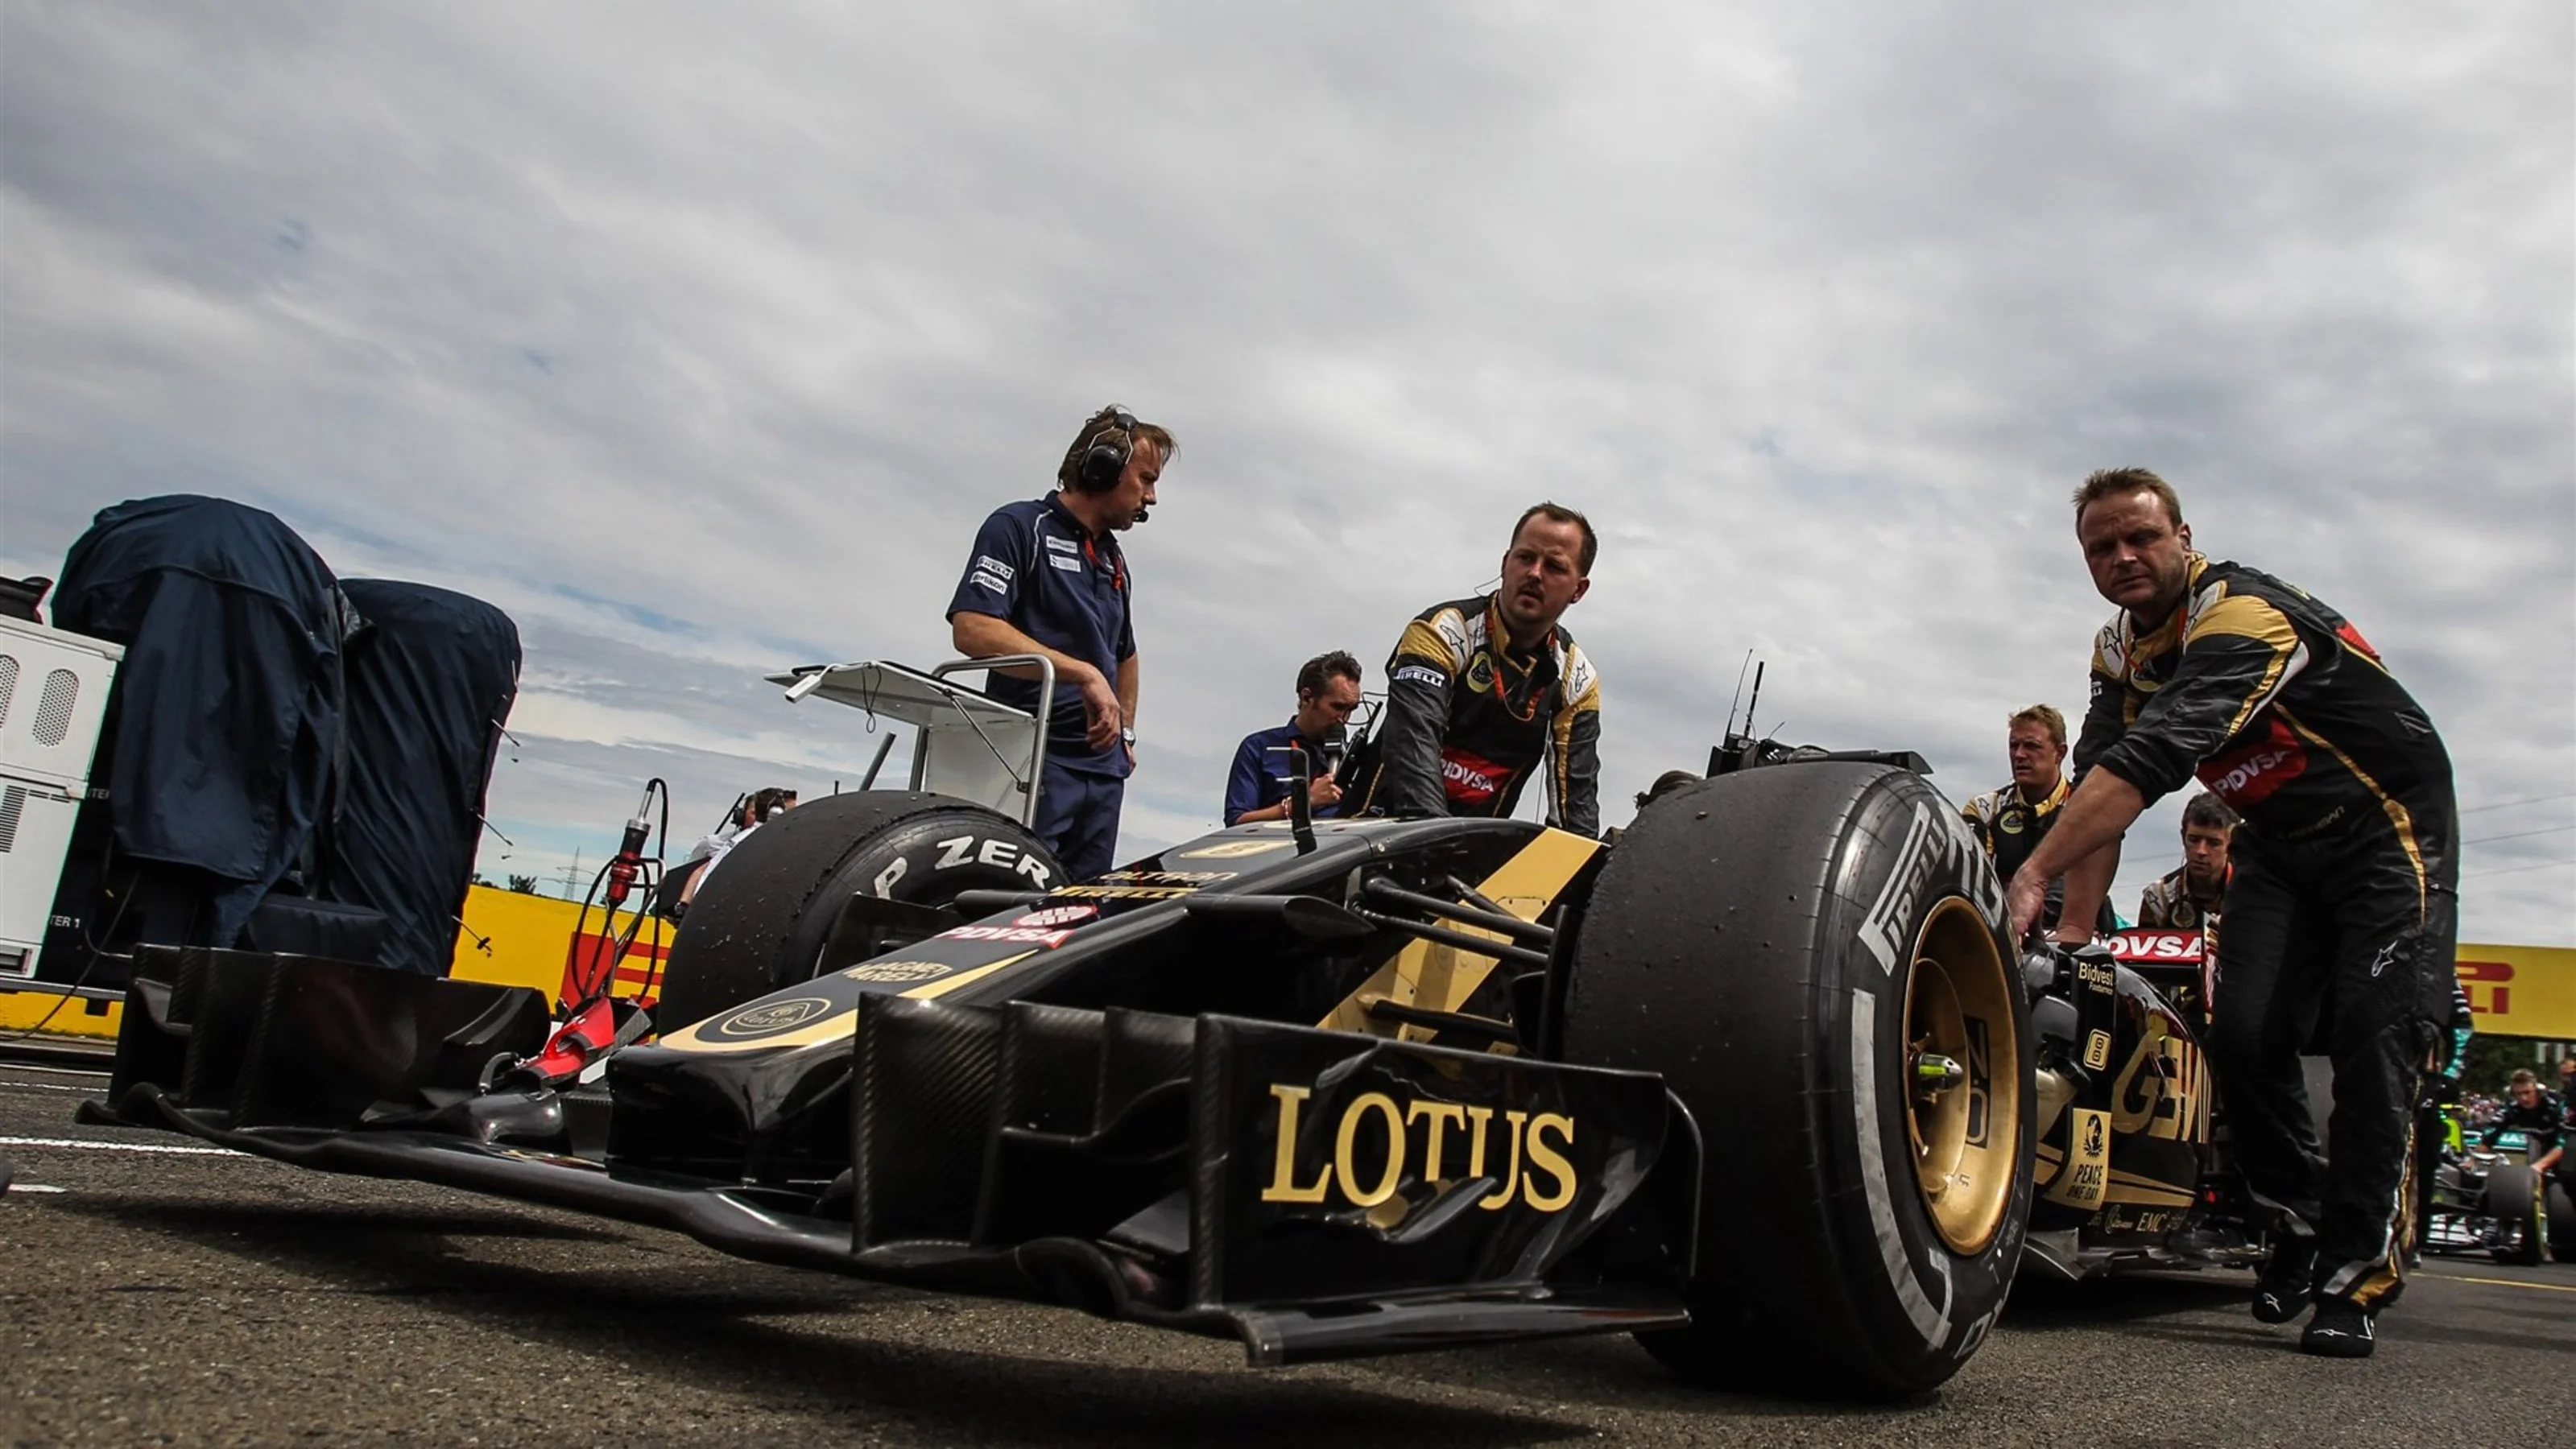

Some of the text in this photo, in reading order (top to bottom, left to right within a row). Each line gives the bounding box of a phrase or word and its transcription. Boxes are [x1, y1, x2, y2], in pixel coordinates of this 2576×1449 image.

[1393, 666, 1445, 687] PIRELLI
[935, 836, 1064, 891] ZER
[1857, 801, 1948, 977] PIRELLI
[2091, 935, 2202, 957] DVSA
[2078, 962, 2114, 986] Bidvest
[1262, 1084, 1577, 1212] LOTUS
[2074, 1164, 2103, 1185] PEACE
[2066, 1185, 2086, 1199] ONE
